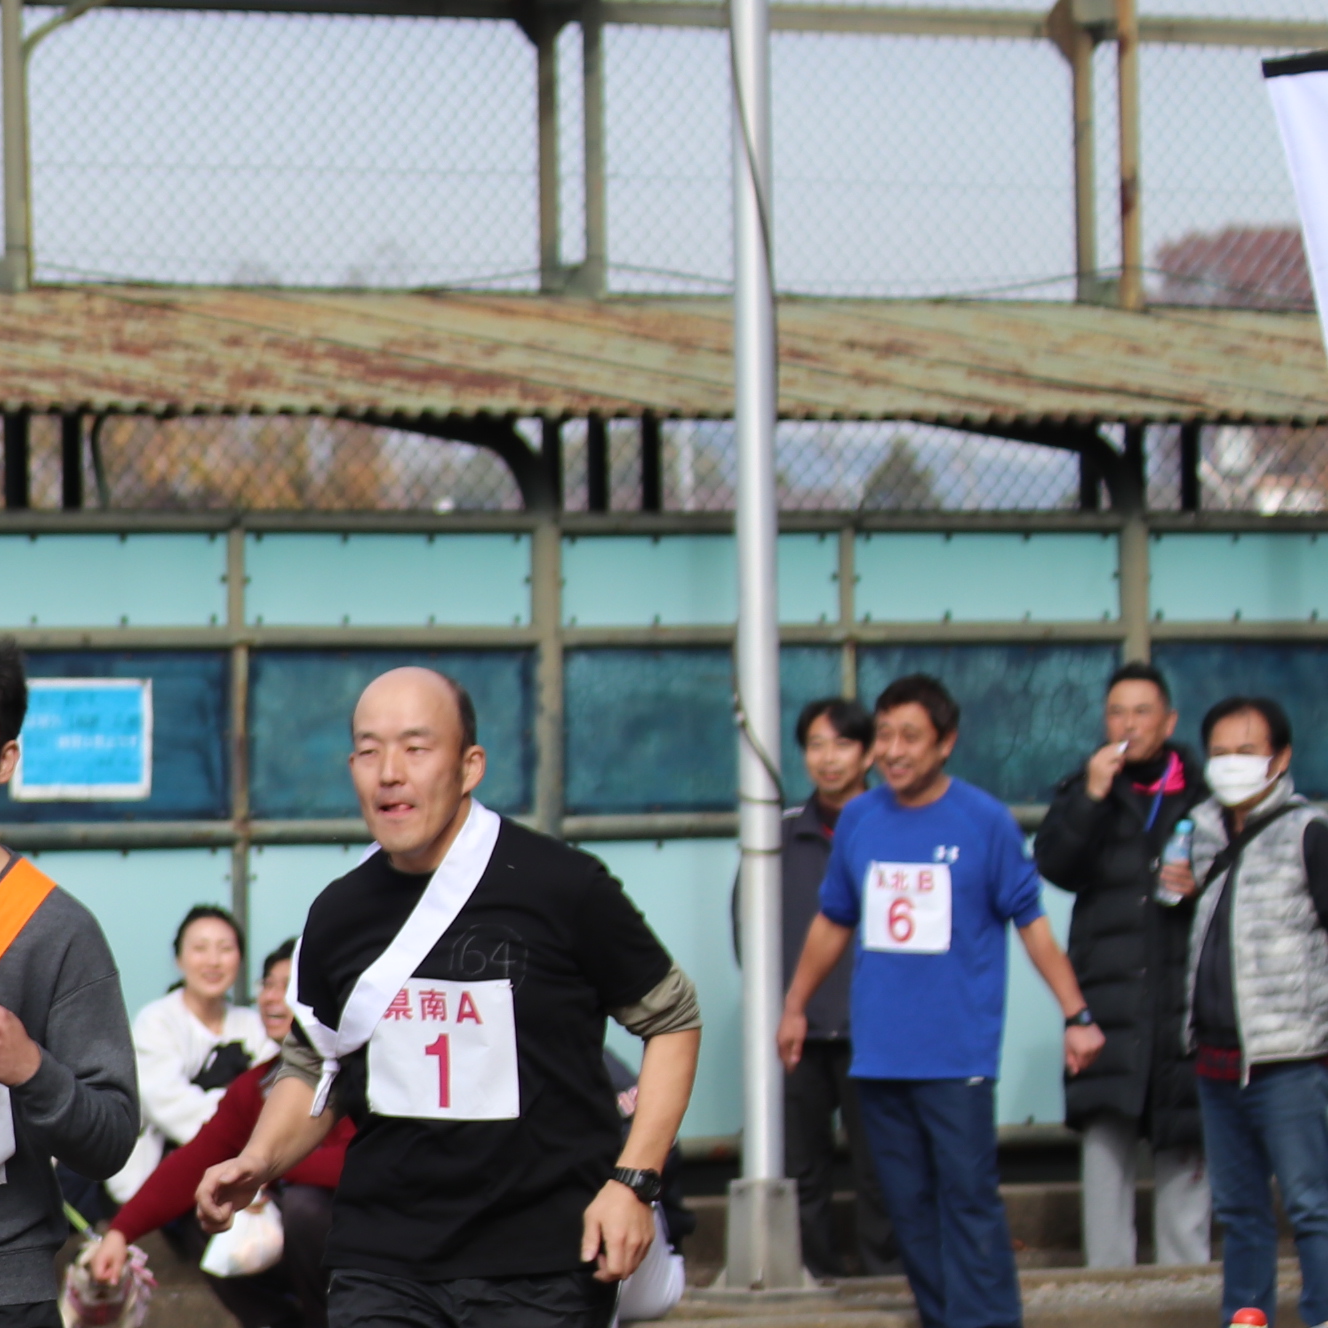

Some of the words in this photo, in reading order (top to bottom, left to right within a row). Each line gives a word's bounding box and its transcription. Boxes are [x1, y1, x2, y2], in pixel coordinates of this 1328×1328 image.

[887, 896, 916, 944] 6
[382, 986, 483, 1025] 県南A
[425, 1033, 451, 1108] 1
